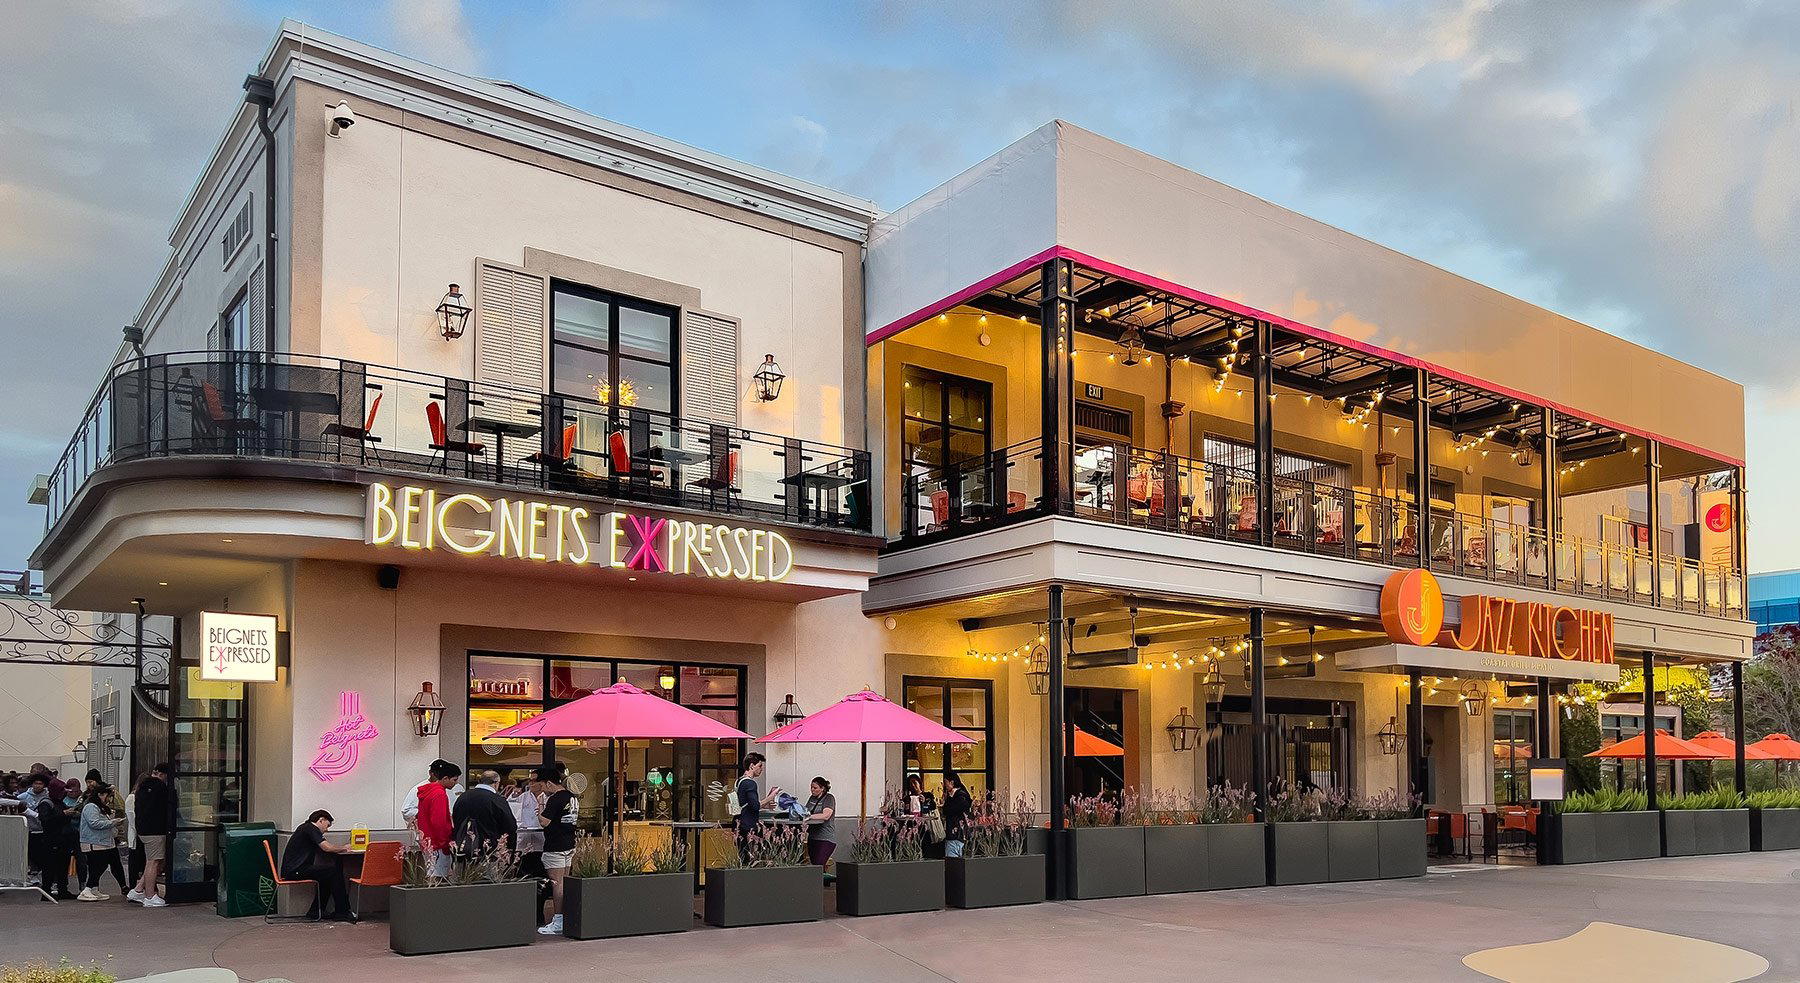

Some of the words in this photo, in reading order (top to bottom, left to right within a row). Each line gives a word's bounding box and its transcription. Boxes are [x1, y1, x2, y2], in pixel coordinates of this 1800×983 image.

[1088, 384, 1102, 399] EXIT
[371, 482, 590, 565] BEIGNETS
[609, 512, 794, 582] EXPRESSED
[209, 627, 268, 646] BEIGNETS
[1450, 593, 1517, 656] JAZZ
[1528, 601, 1616, 665] KITCHEN
[209, 645, 271, 664] EXPRESSED
[334, 714, 365, 733] Hot
[320, 726, 379, 750] Beignets
